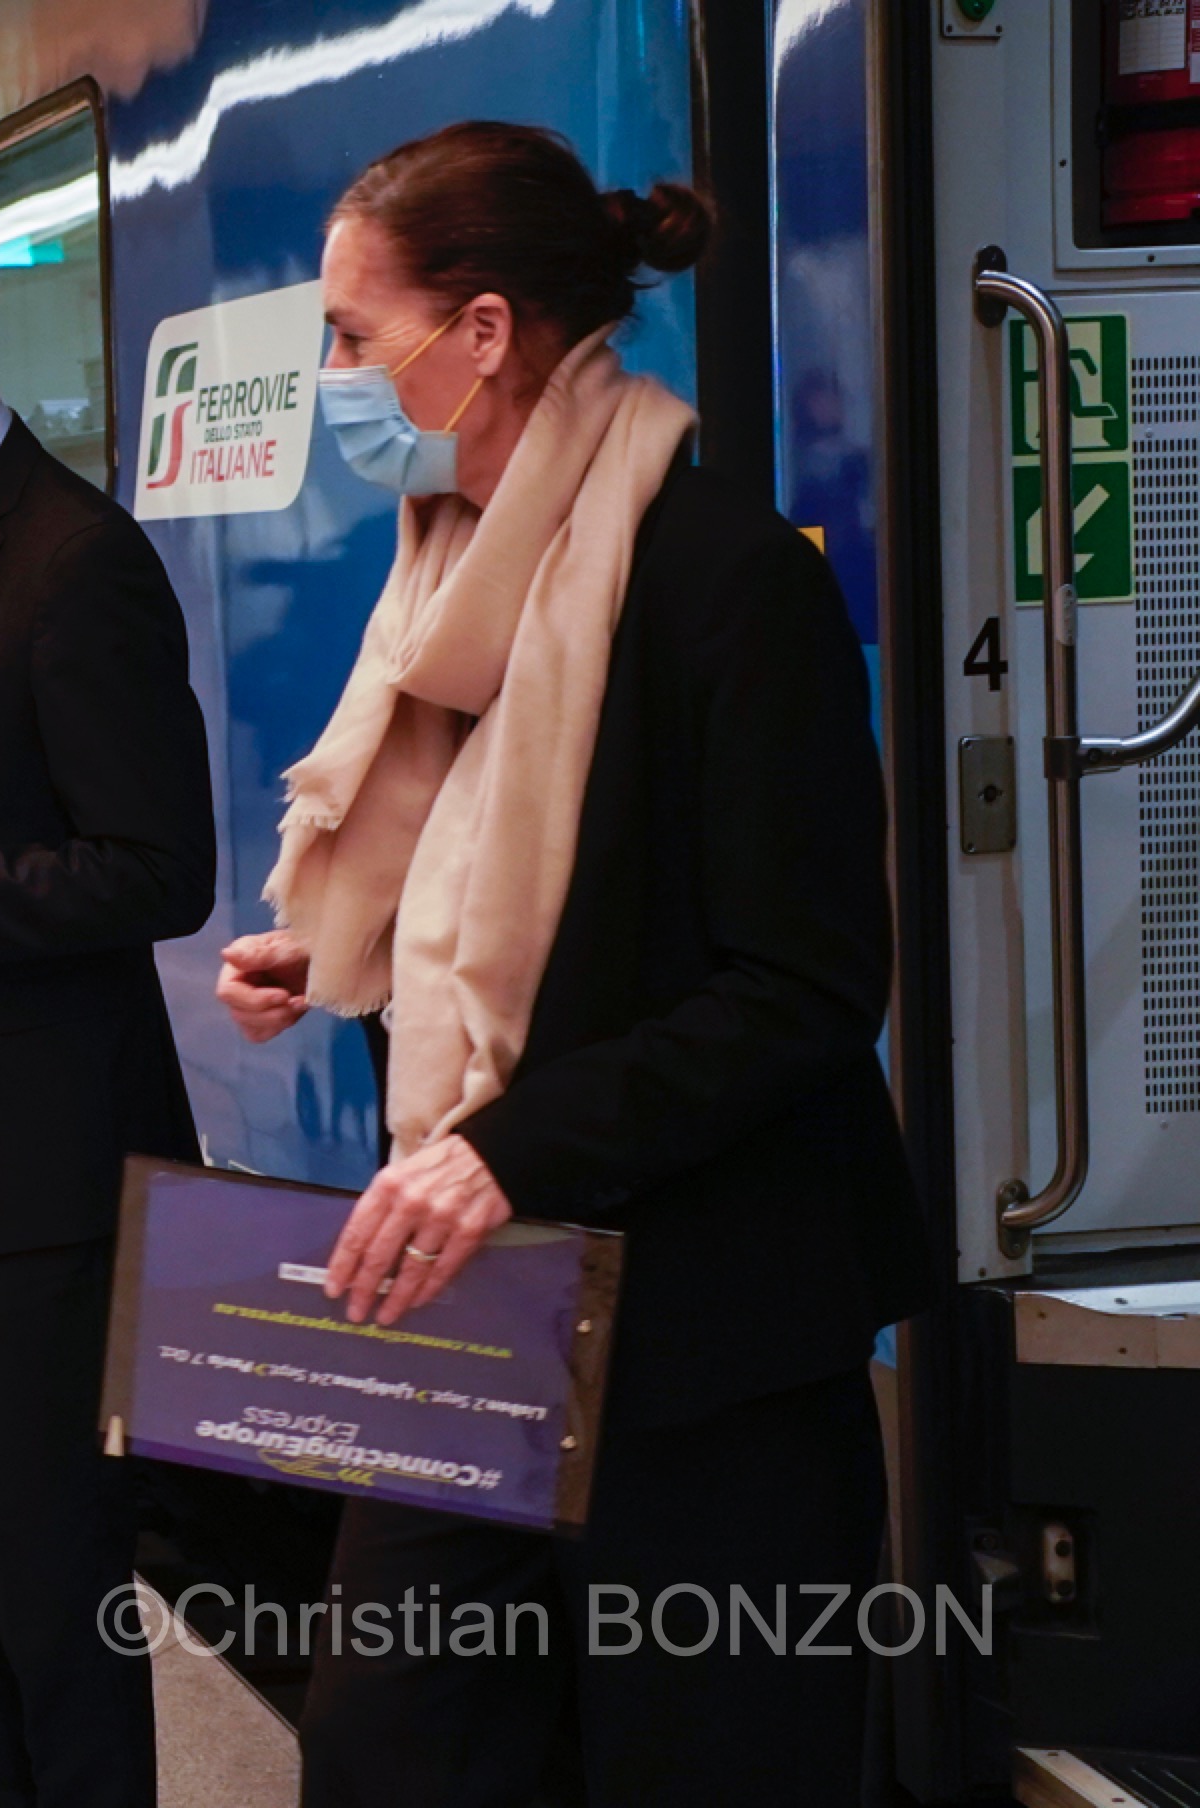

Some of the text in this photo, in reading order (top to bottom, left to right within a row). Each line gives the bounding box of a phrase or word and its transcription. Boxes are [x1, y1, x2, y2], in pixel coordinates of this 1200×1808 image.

[196, 370, 300, 424] FERROVIE
[204, 420, 263, 444] DELLO STATO
[190, 439, 277, 485] ITALIANE
[963, 617, 1008, 691] 4
[190, 1352, 206, 1365] 7
[243, 1405, 360, 1444] Express
[195, 1420, 503, 1489] #ConnectingEurope
